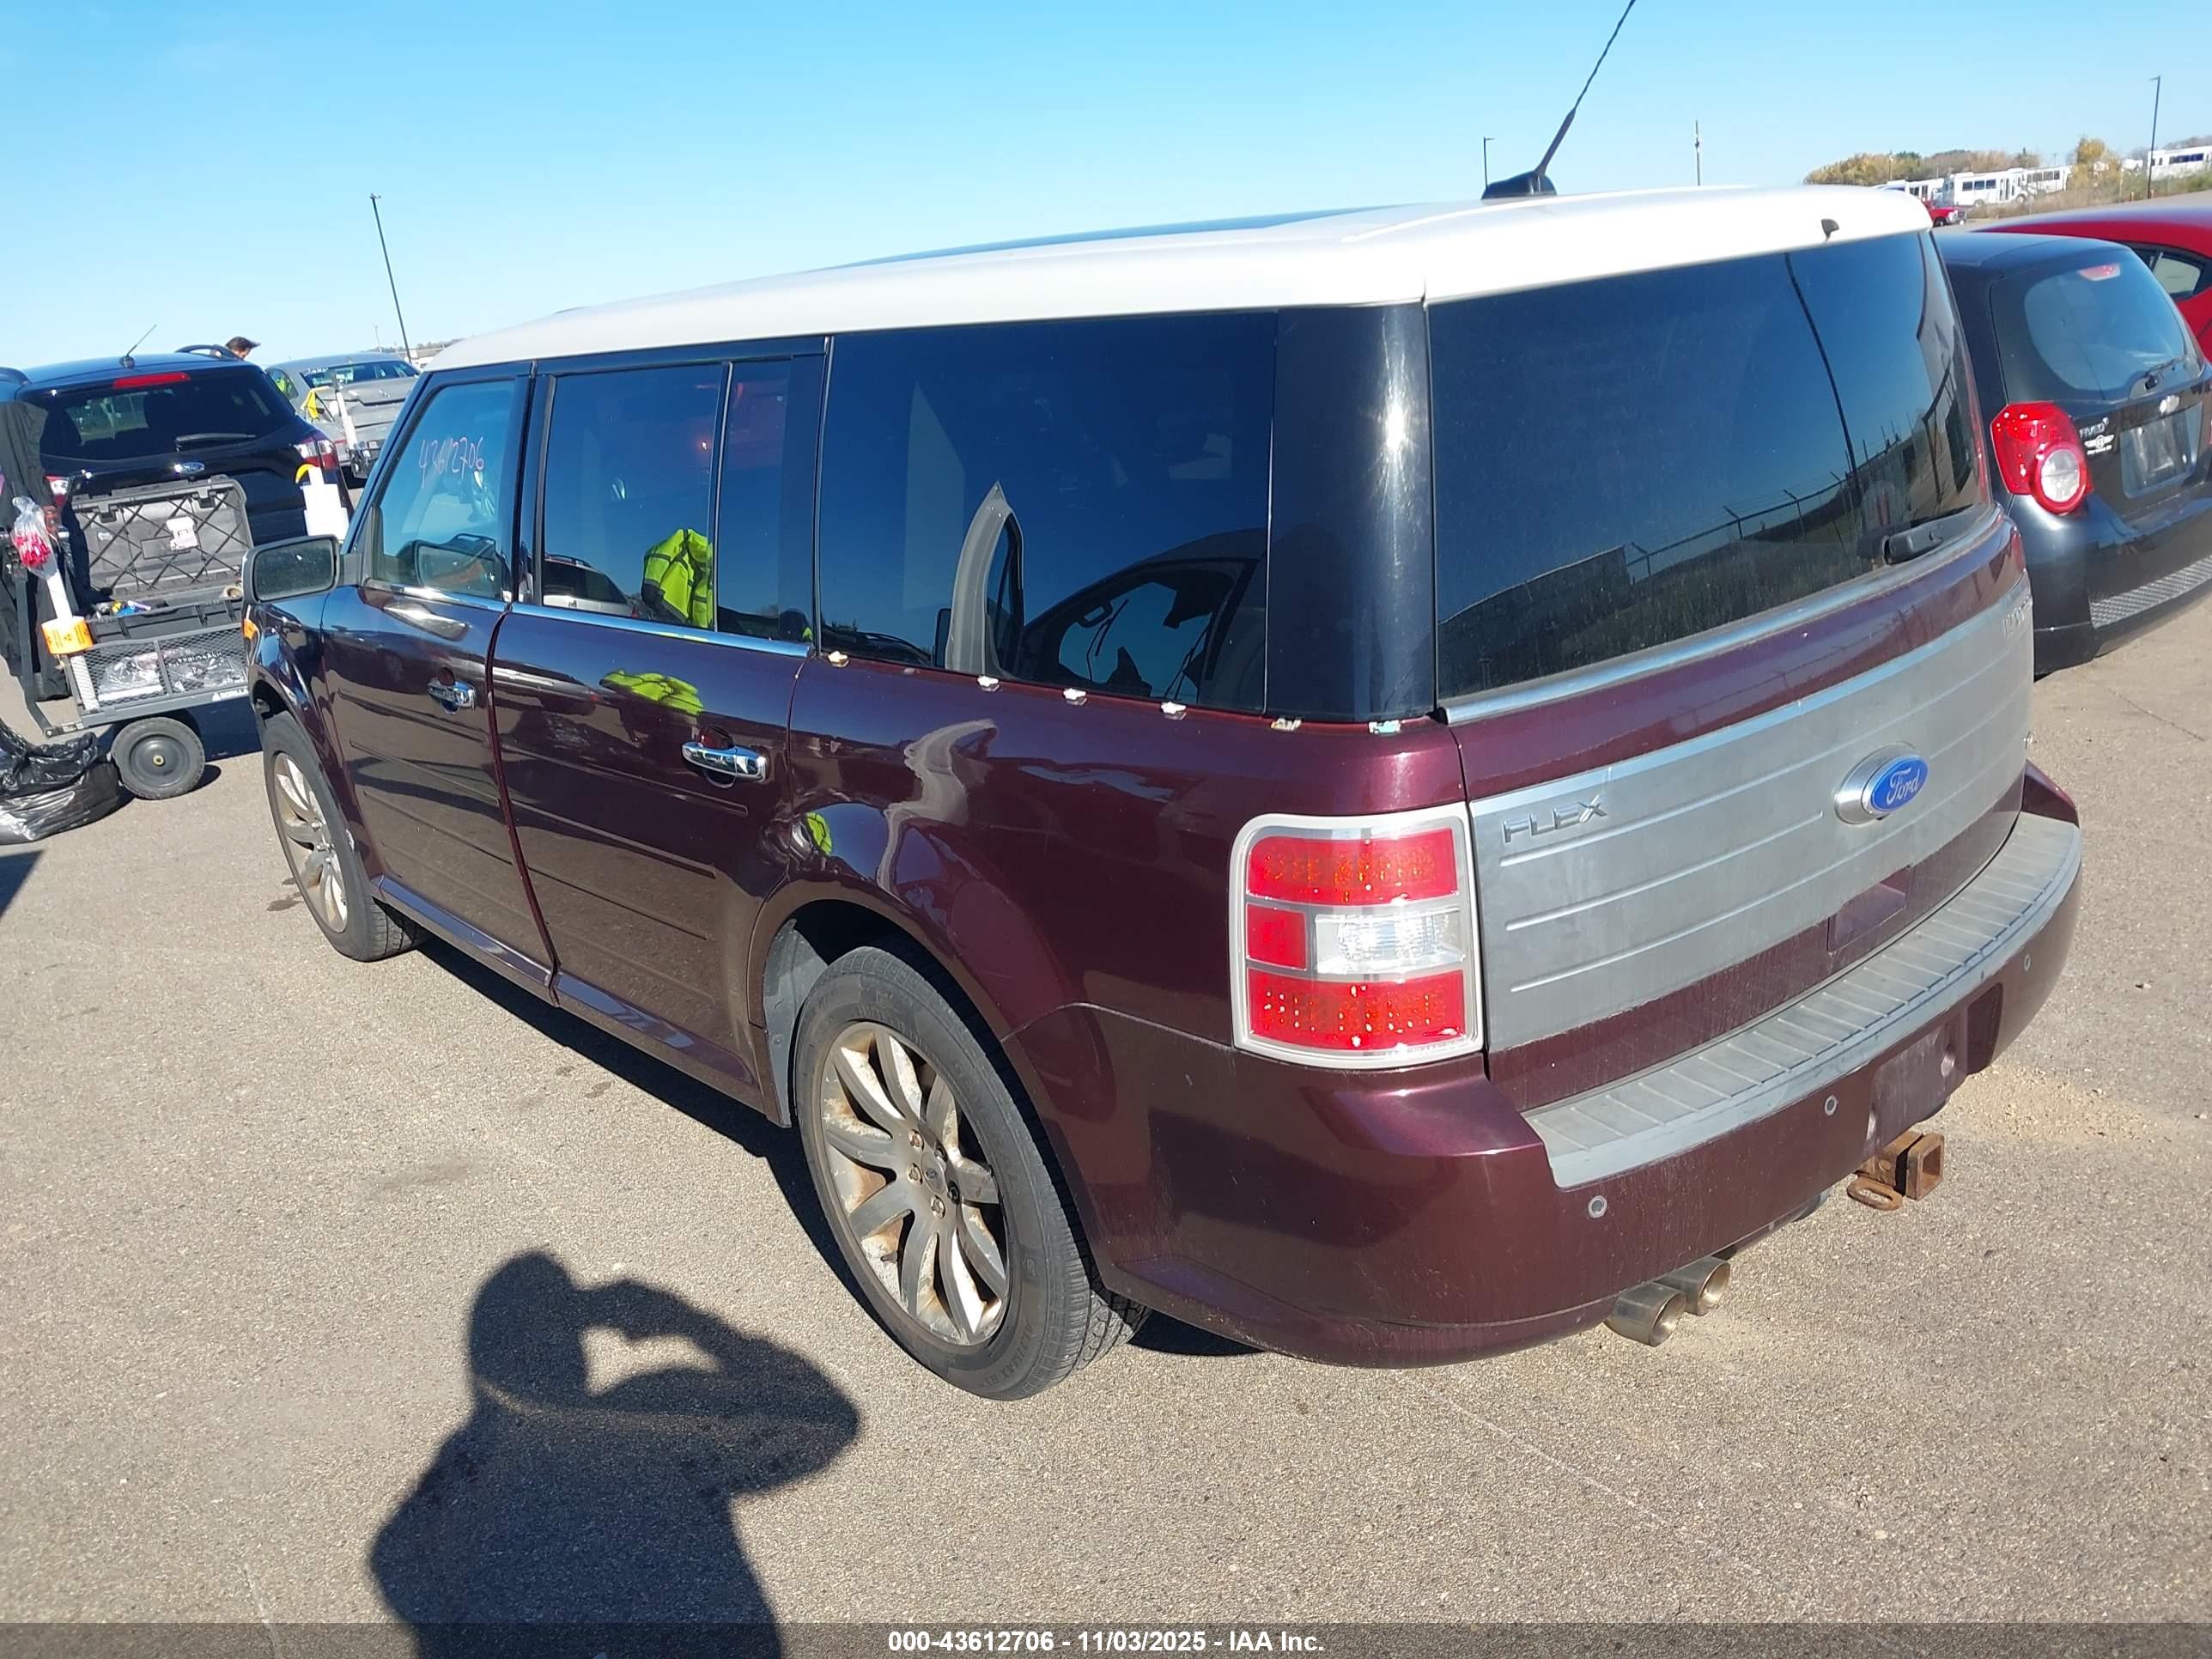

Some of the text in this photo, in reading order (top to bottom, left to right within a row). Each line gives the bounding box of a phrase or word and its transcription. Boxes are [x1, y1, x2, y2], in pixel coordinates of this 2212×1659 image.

[418, 436, 484, 489] 43612706
[1886, 767, 1920, 805] Ford
[1502, 794, 1607, 843] FLEX
